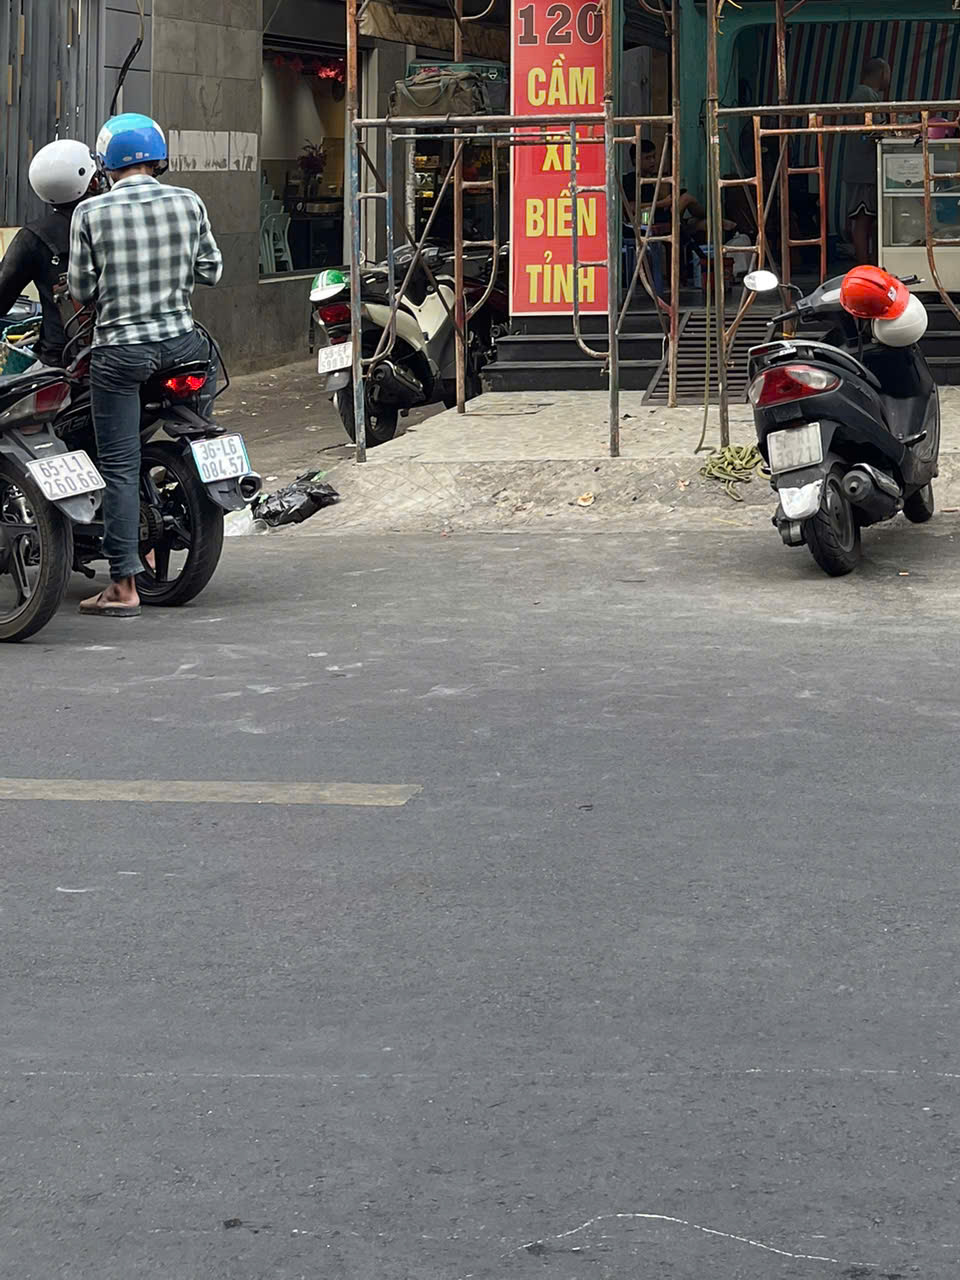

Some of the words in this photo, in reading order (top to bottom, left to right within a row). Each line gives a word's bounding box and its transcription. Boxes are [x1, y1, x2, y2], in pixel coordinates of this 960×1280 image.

[517, 1, 606, 47] 120
[526, 53, 596, 106] CẦM
[541, 131, 581, 172] XE
[525, 249, 595, 304] TỈNH
[199, 439, 238, 460] 36-L6
[39, 456, 84, 478] 65-L1
[201, 455, 245, 480] 084.57
[43, 471, 101, 497] 260.66
